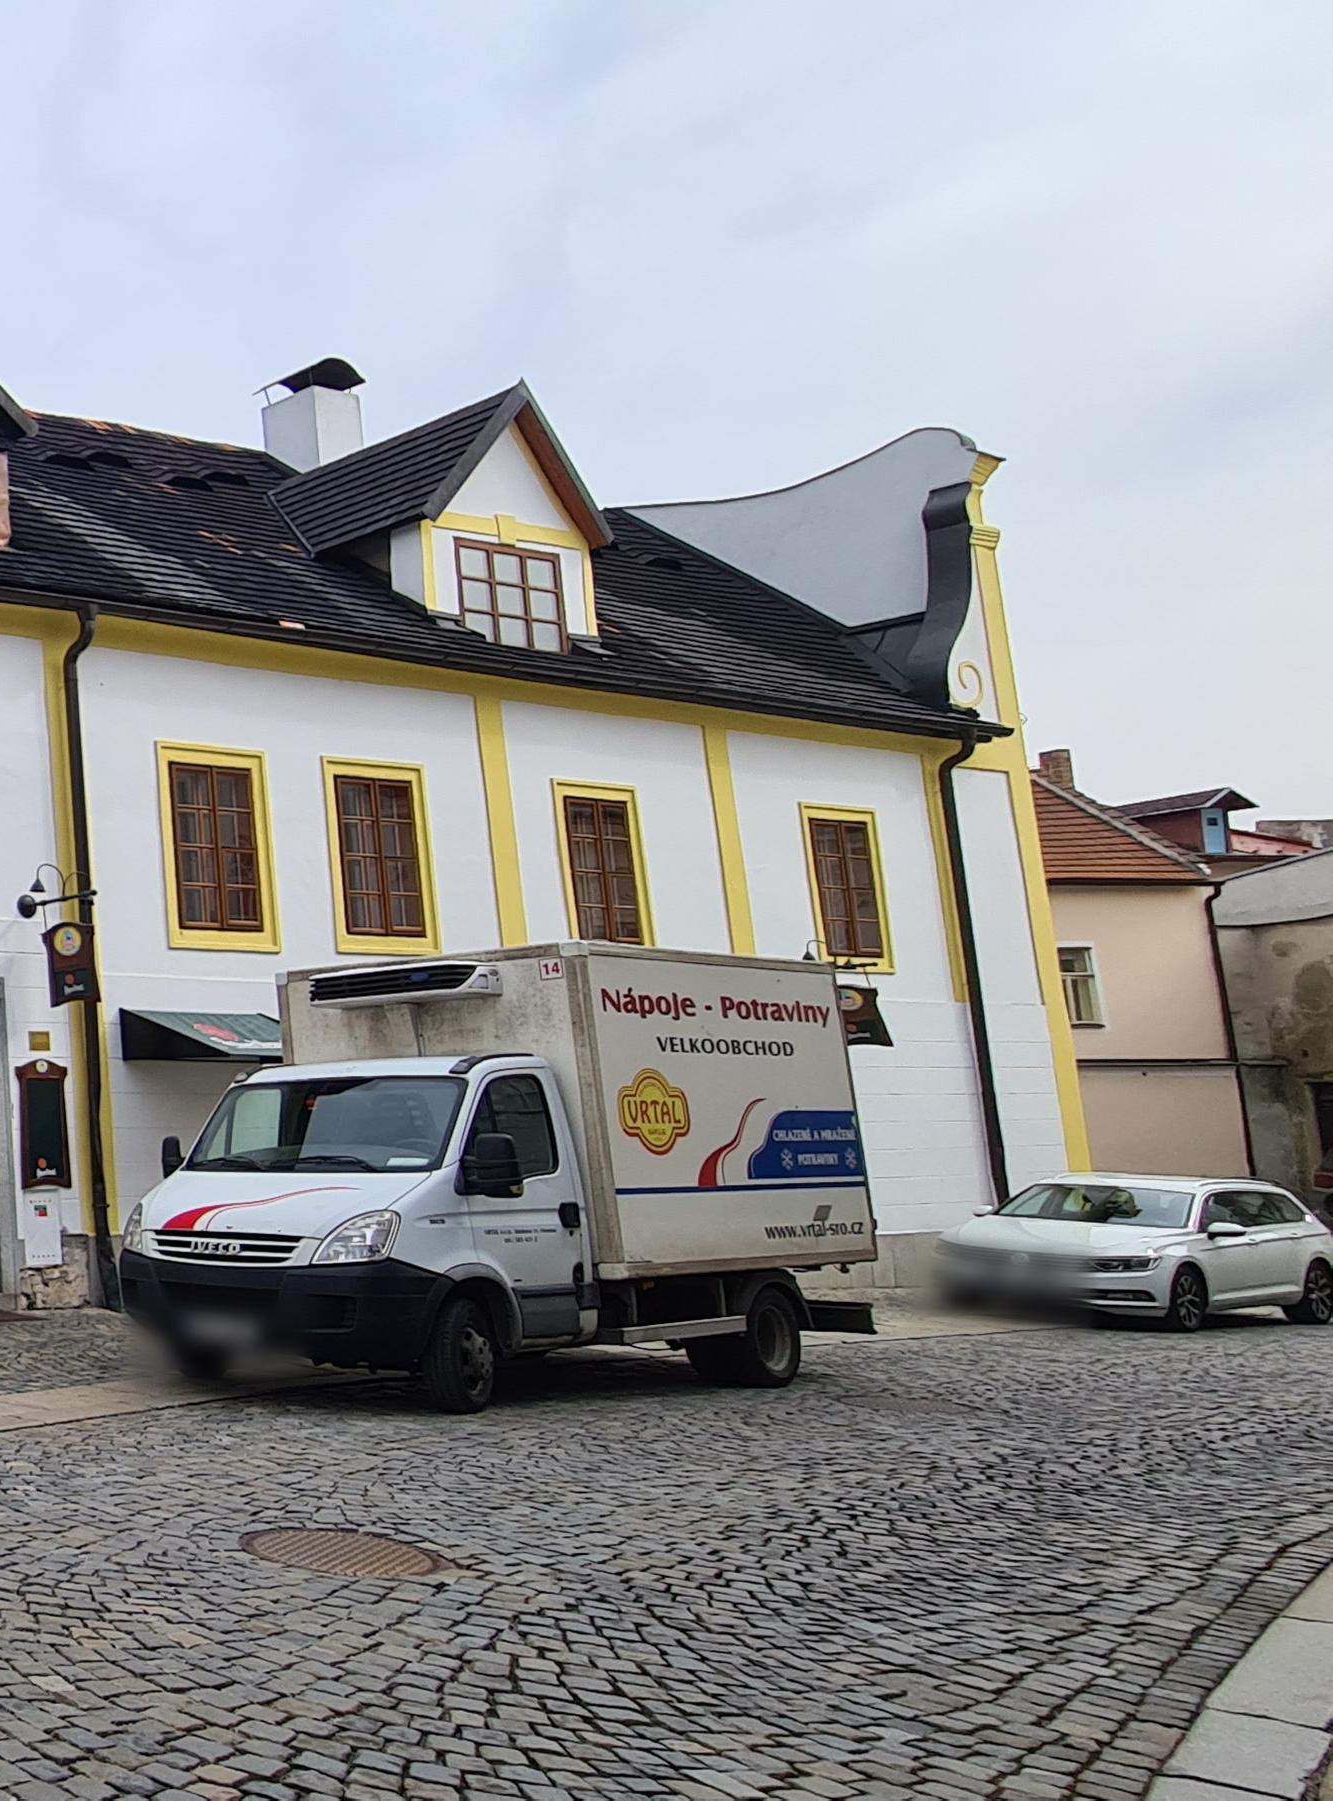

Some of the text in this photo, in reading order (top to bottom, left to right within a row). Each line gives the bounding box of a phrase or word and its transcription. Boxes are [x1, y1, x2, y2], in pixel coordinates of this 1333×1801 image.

[542, 962, 561, 976] 14
[600, 987, 697, 1021] Nápoje
[720, 996, 830, 1029] Potraviny
[656, 1036, 795, 1057] VELKOOBCHOD
[627, 1099, 682, 1124] VRTAL
[764, 1221, 864, 1239] www.vrtal-sro.cz
[190, 1240, 240, 1255] IVECO
